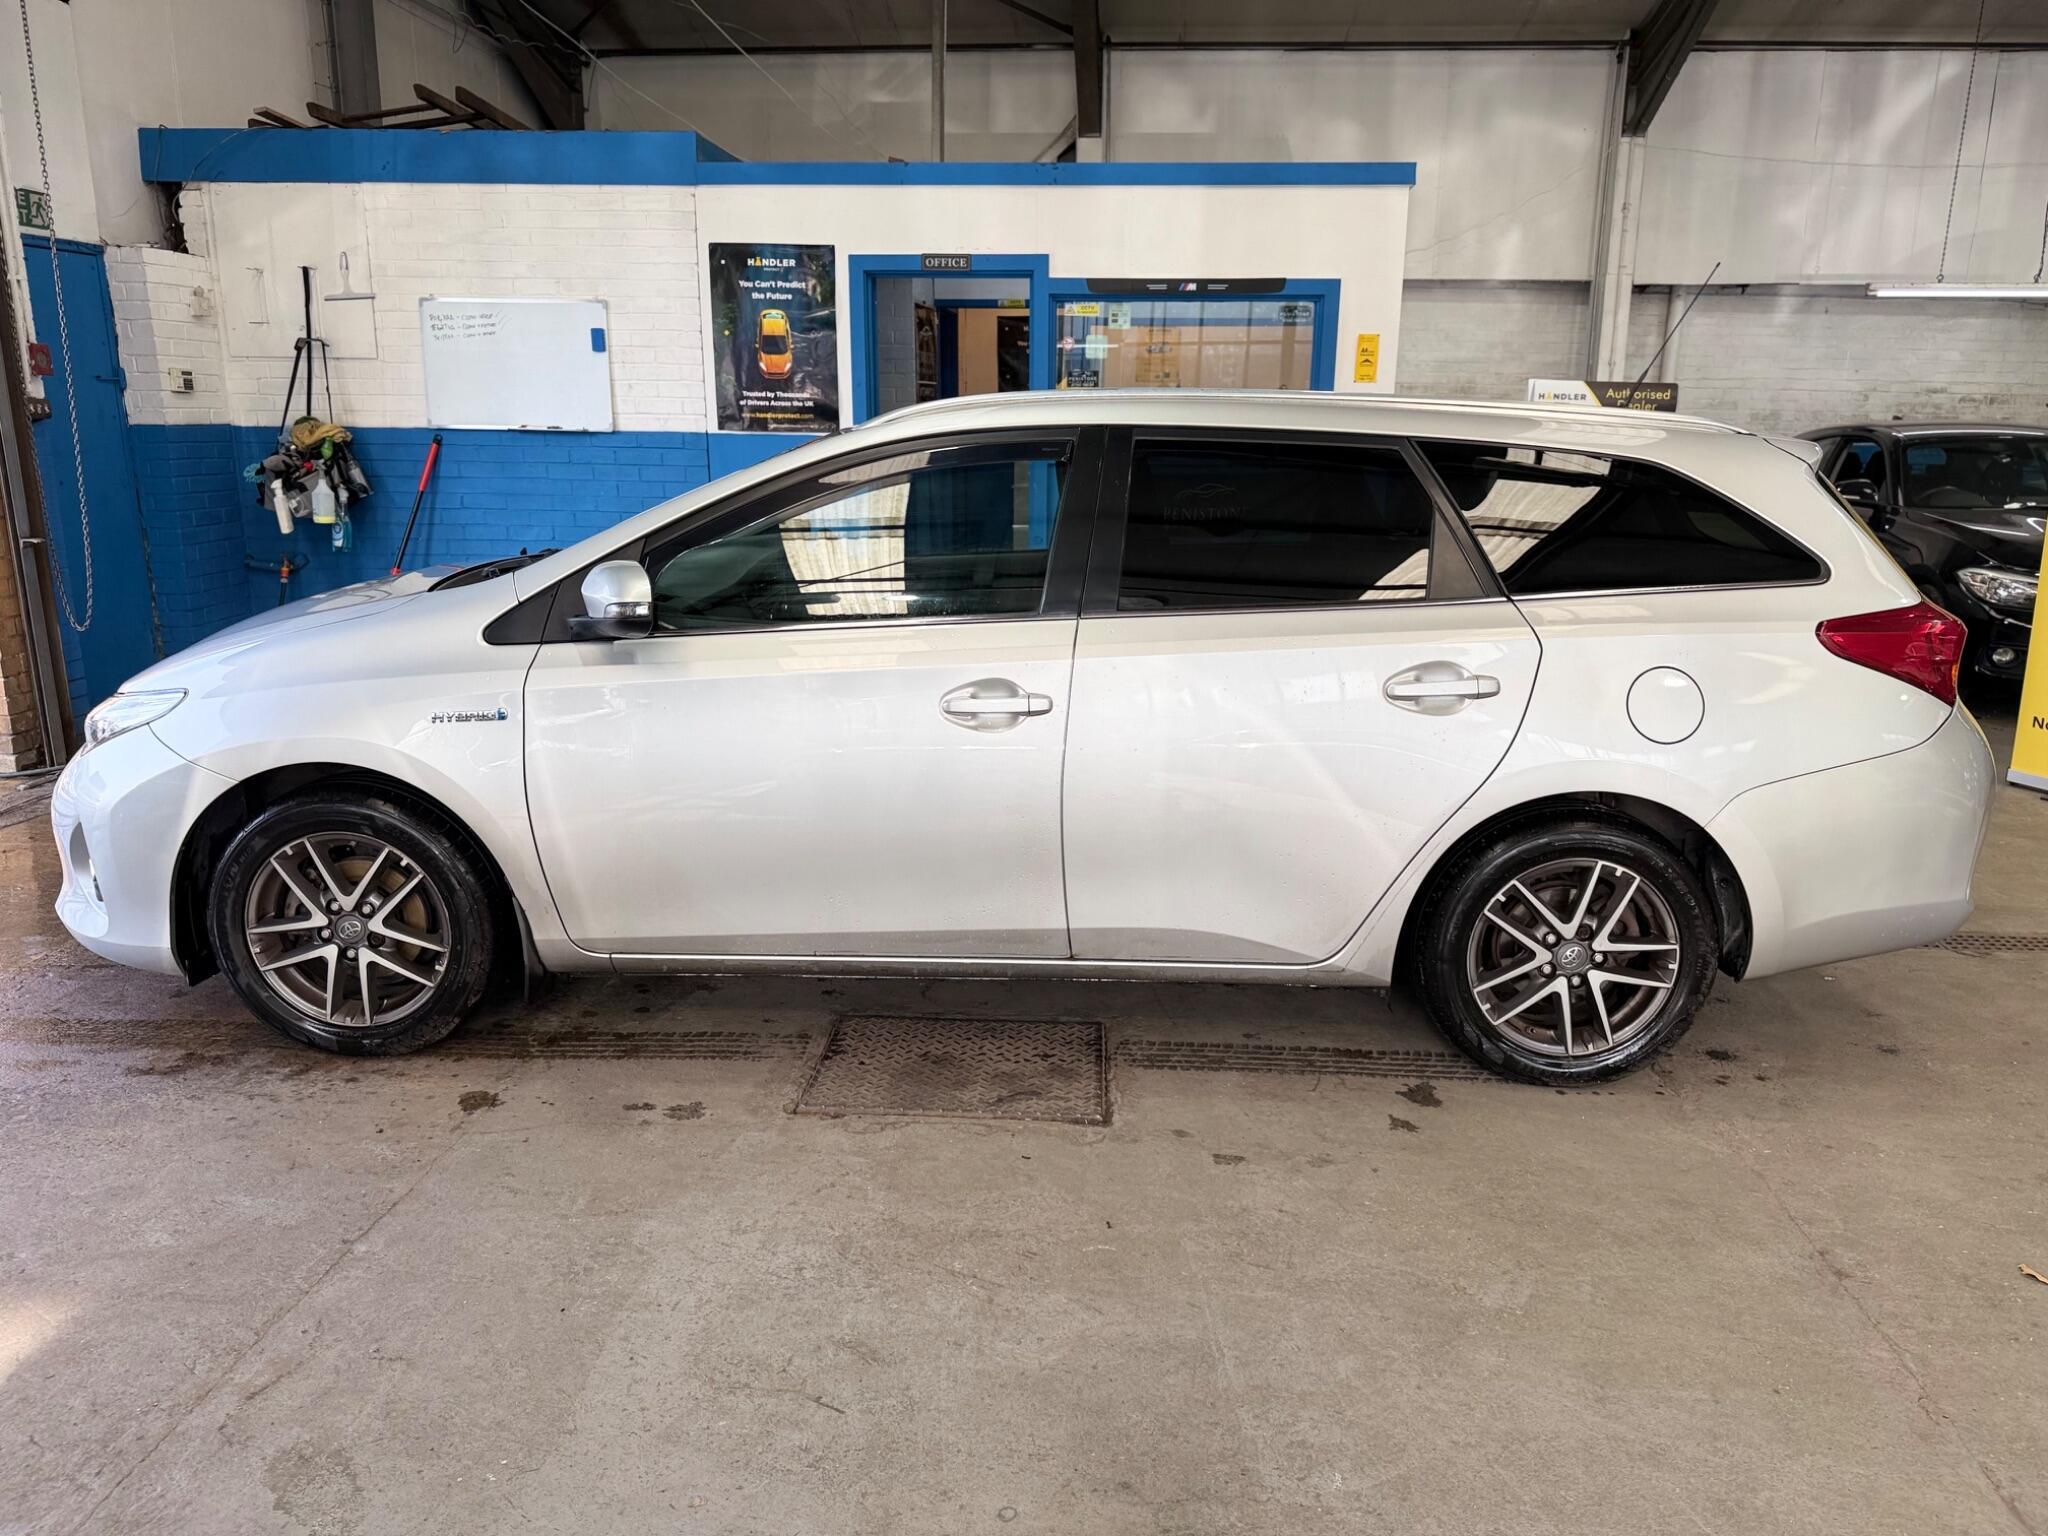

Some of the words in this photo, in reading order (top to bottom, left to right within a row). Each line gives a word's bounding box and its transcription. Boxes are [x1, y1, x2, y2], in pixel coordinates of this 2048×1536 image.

[925, 257, 967, 268] OFFICE
[739, 280, 753, 289] You
[754, 280, 775, 289] Can't
[777, 280, 806, 290] Predict
[751, 291, 765, 300] the
[766, 291, 793, 301] Future
[767, 391, 775, 399] by
